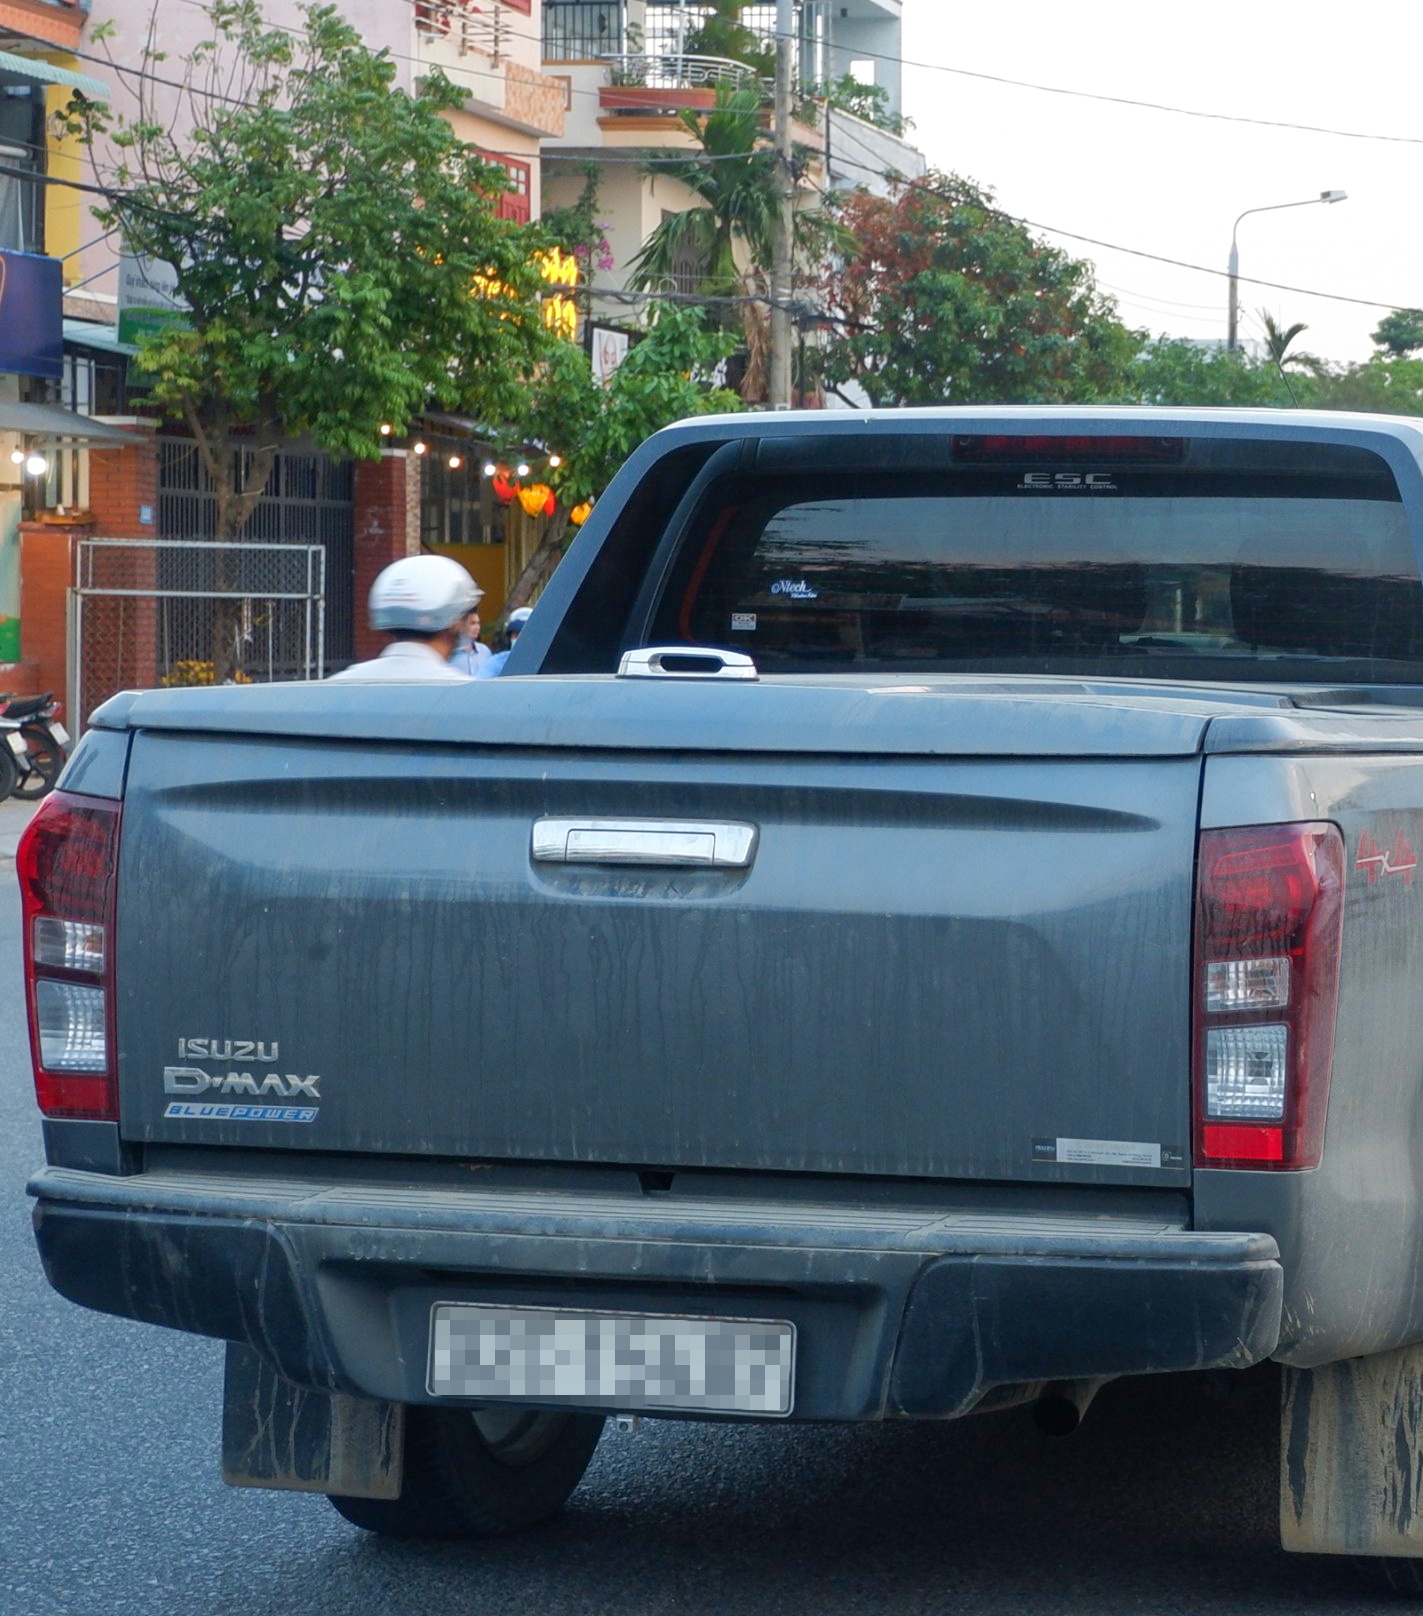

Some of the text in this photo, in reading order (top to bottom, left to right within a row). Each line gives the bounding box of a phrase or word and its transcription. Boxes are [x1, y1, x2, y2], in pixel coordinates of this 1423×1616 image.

[1024, 472, 1112, 485] ESC
[178, 1037, 279, 1063] ISUZU
[163, 1066, 321, 1098] D-MAX
